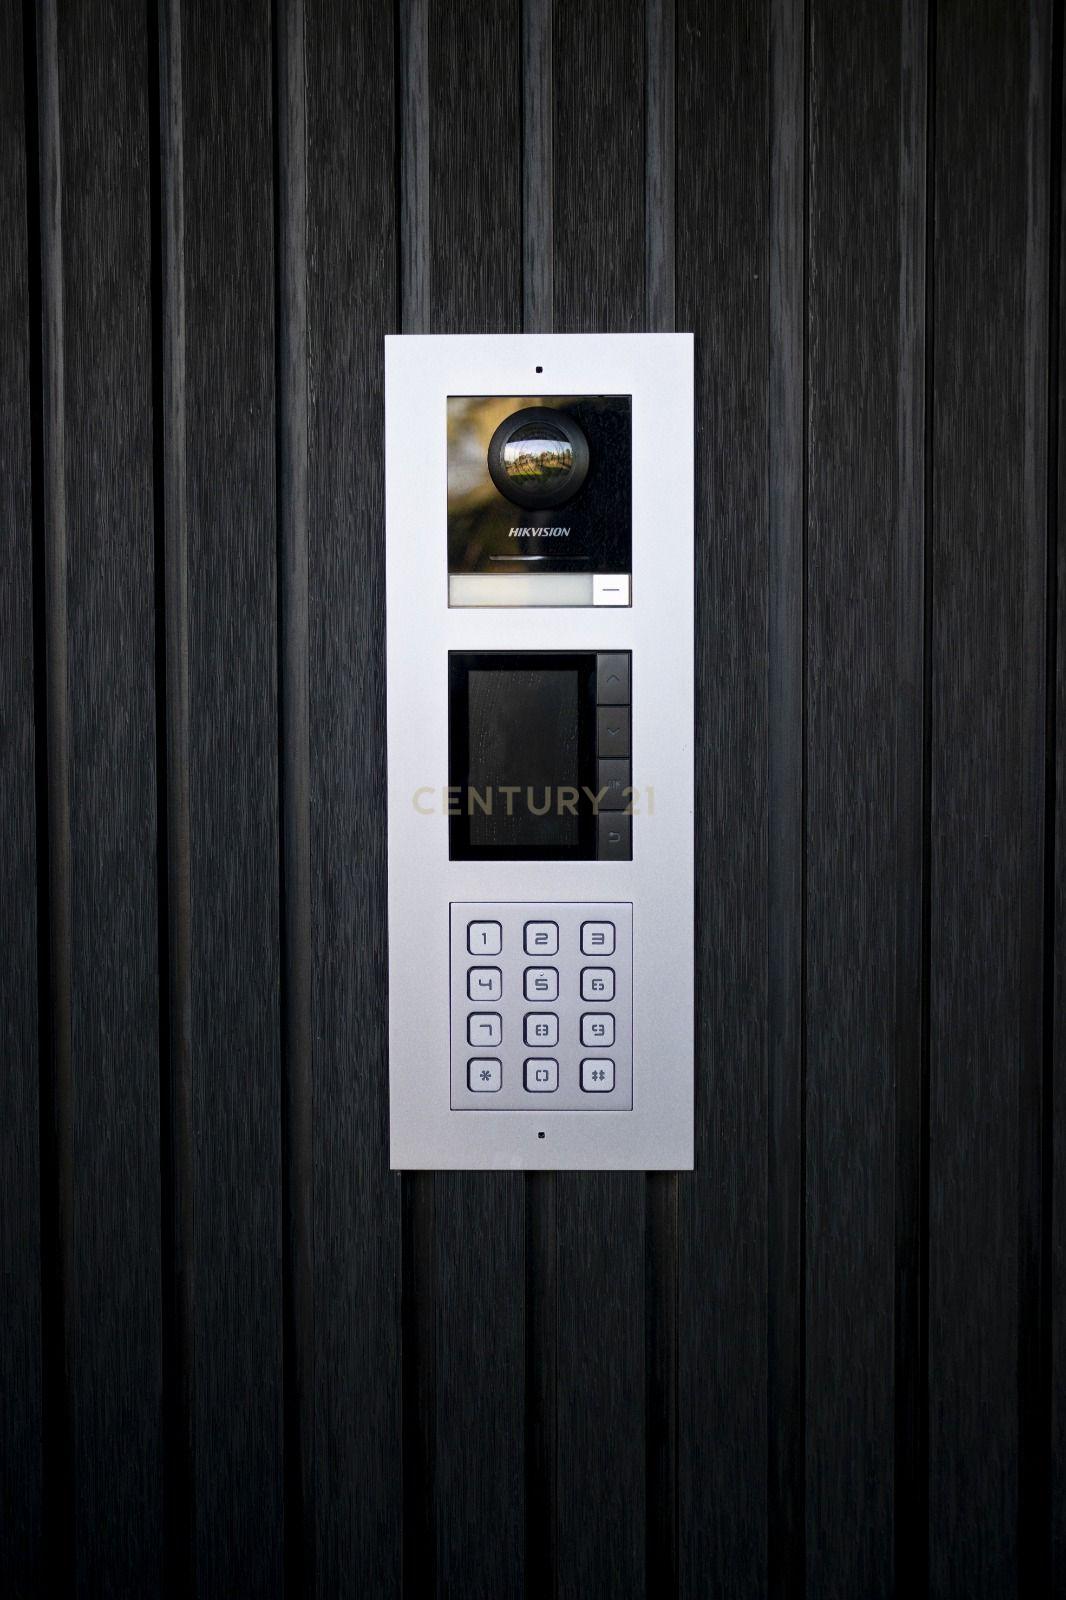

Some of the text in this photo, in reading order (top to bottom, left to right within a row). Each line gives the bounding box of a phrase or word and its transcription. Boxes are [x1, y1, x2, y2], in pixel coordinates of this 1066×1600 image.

[508, 527, 571, 537] HIKVISION
[481, 932, 605, 945] 1 2 3
[479, 978, 605, 991] 4 5 6
[479, 1024, 605, 1036] 7 8 9
